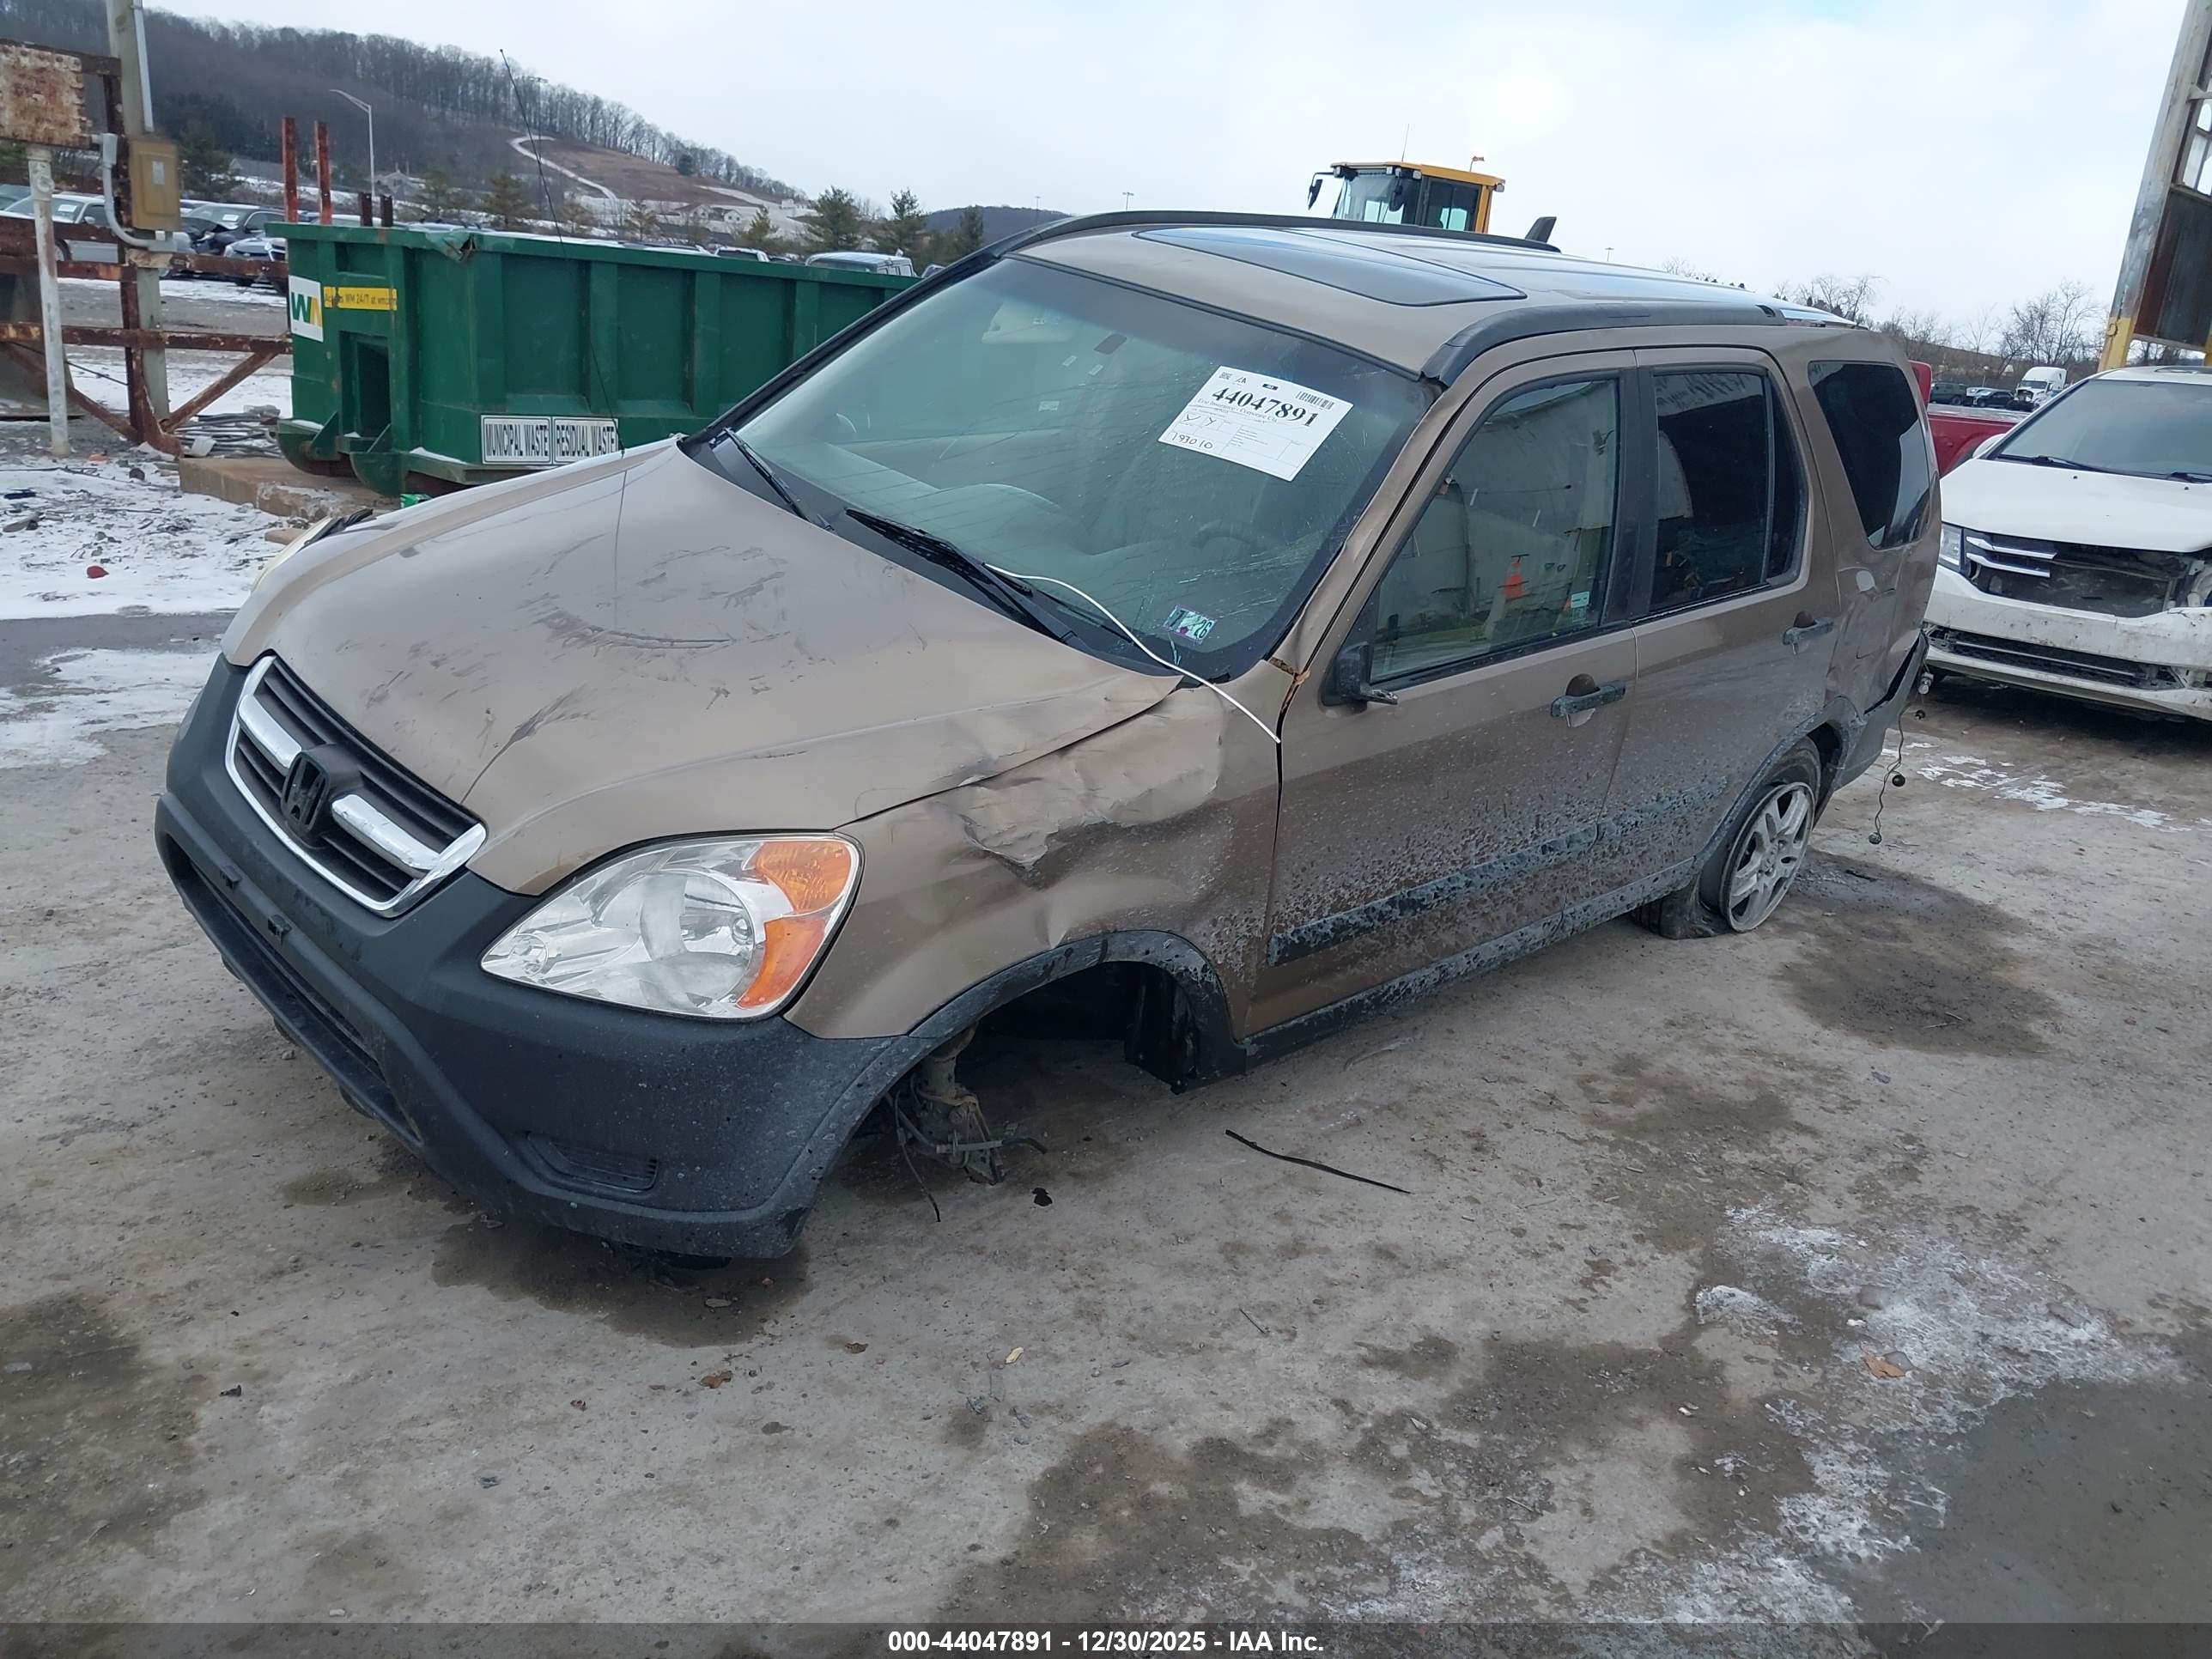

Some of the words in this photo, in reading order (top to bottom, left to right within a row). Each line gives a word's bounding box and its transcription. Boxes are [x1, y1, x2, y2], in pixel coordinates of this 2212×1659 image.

[1212, 387, 1319, 427] 44047891
[486, 423, 523, 457] MUNICIPAL
[525, 424, 548, 457] WASTE
[556, 424, 590, 457] RESIDUAL
[591, 425, 615, 456] WASTE
[1194, 619, 1212, 638] 26
